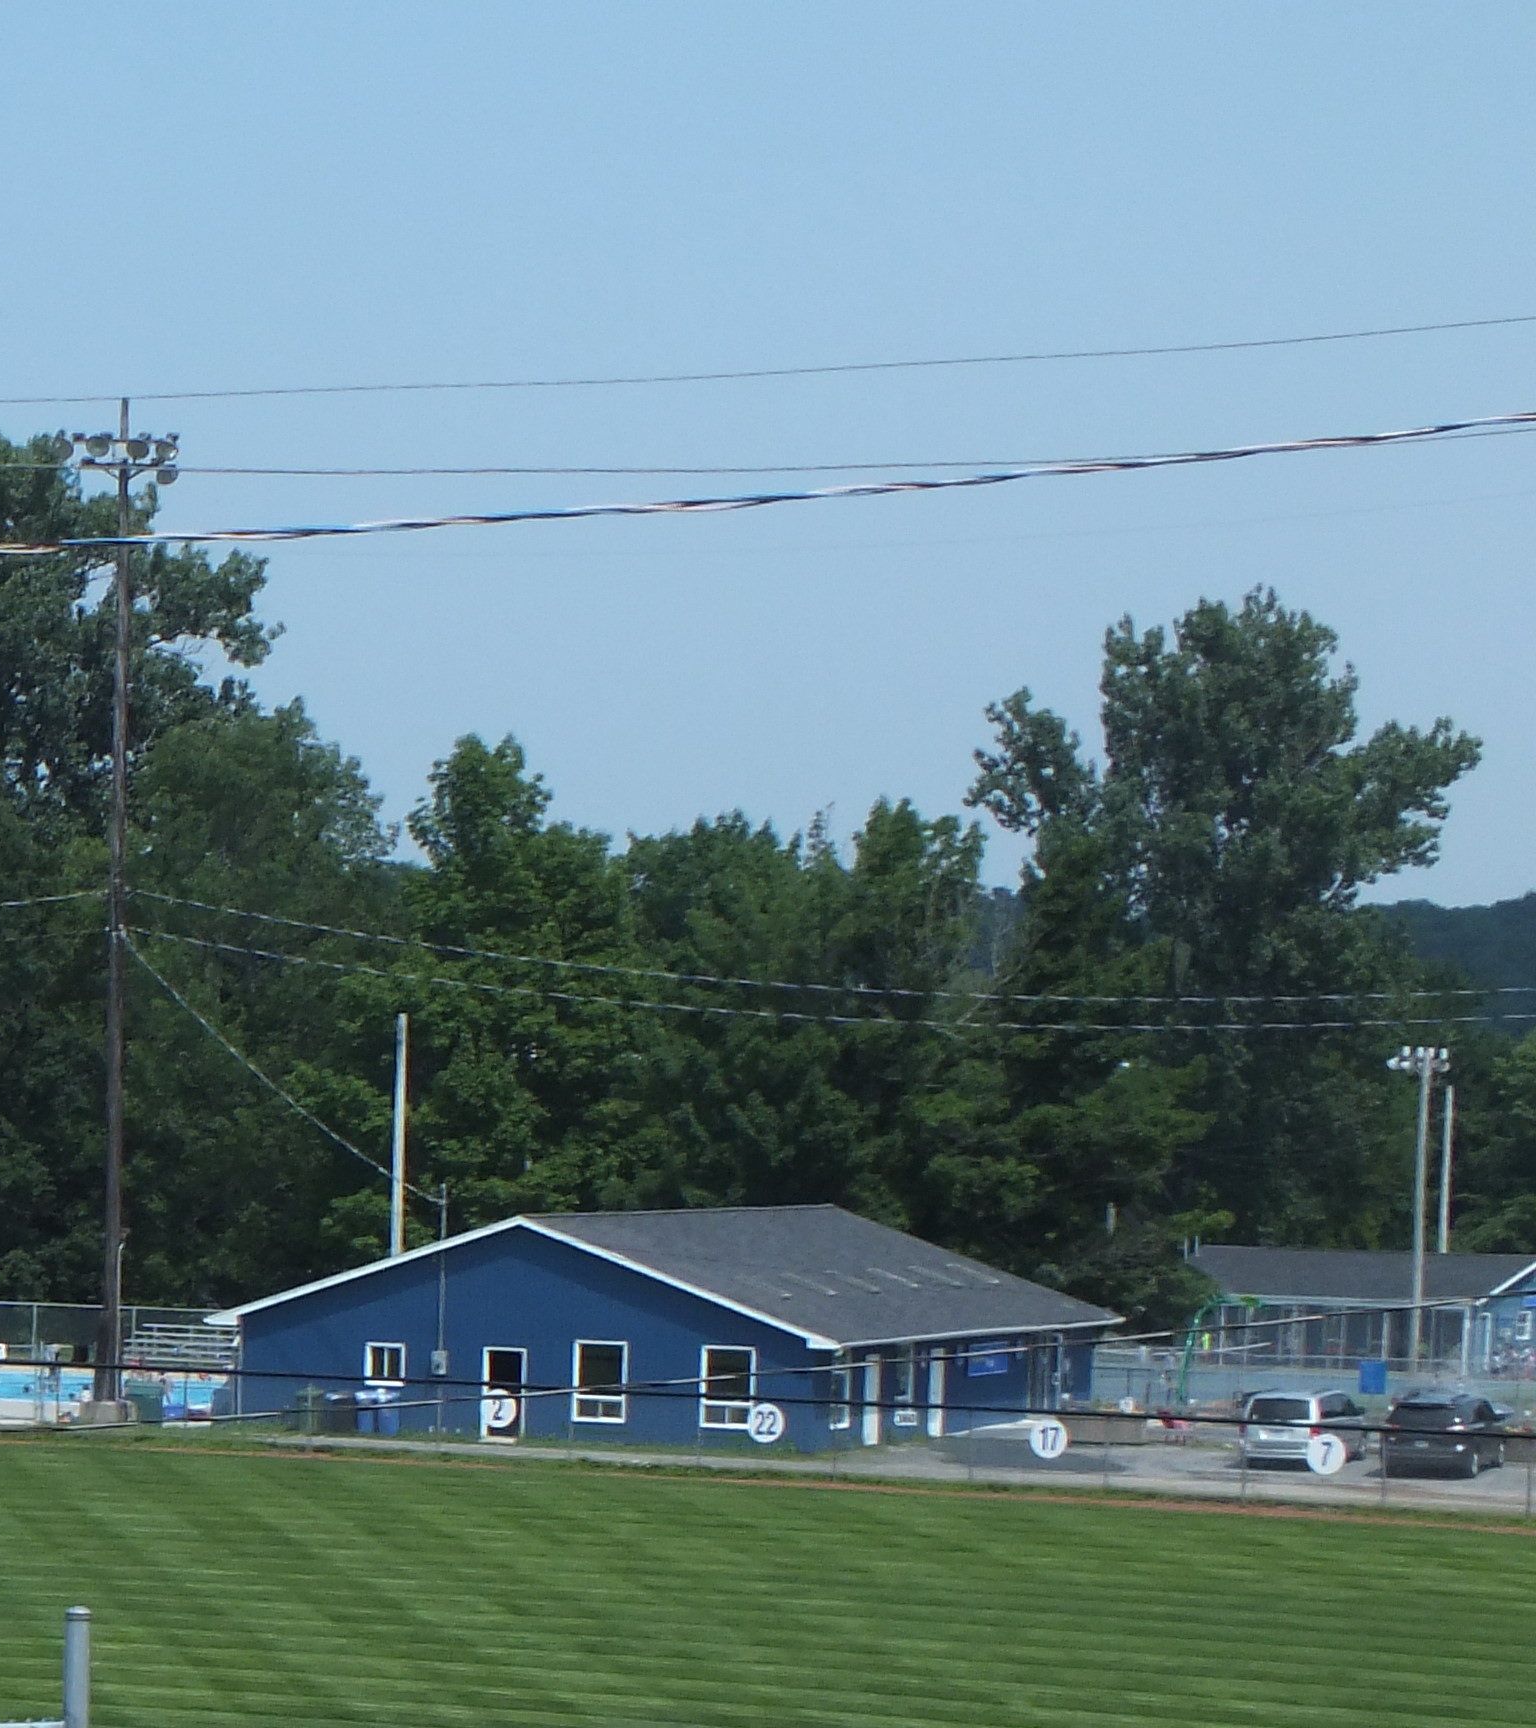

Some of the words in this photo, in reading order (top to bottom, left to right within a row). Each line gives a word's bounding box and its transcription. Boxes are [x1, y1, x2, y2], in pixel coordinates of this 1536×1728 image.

[492, 1397, 503, 1421] 2
[756, 1411, 778, 1435] 22
[1039, 1427, 1060, 1451] 17
[1321, 1442, 1332, 1467] 7
